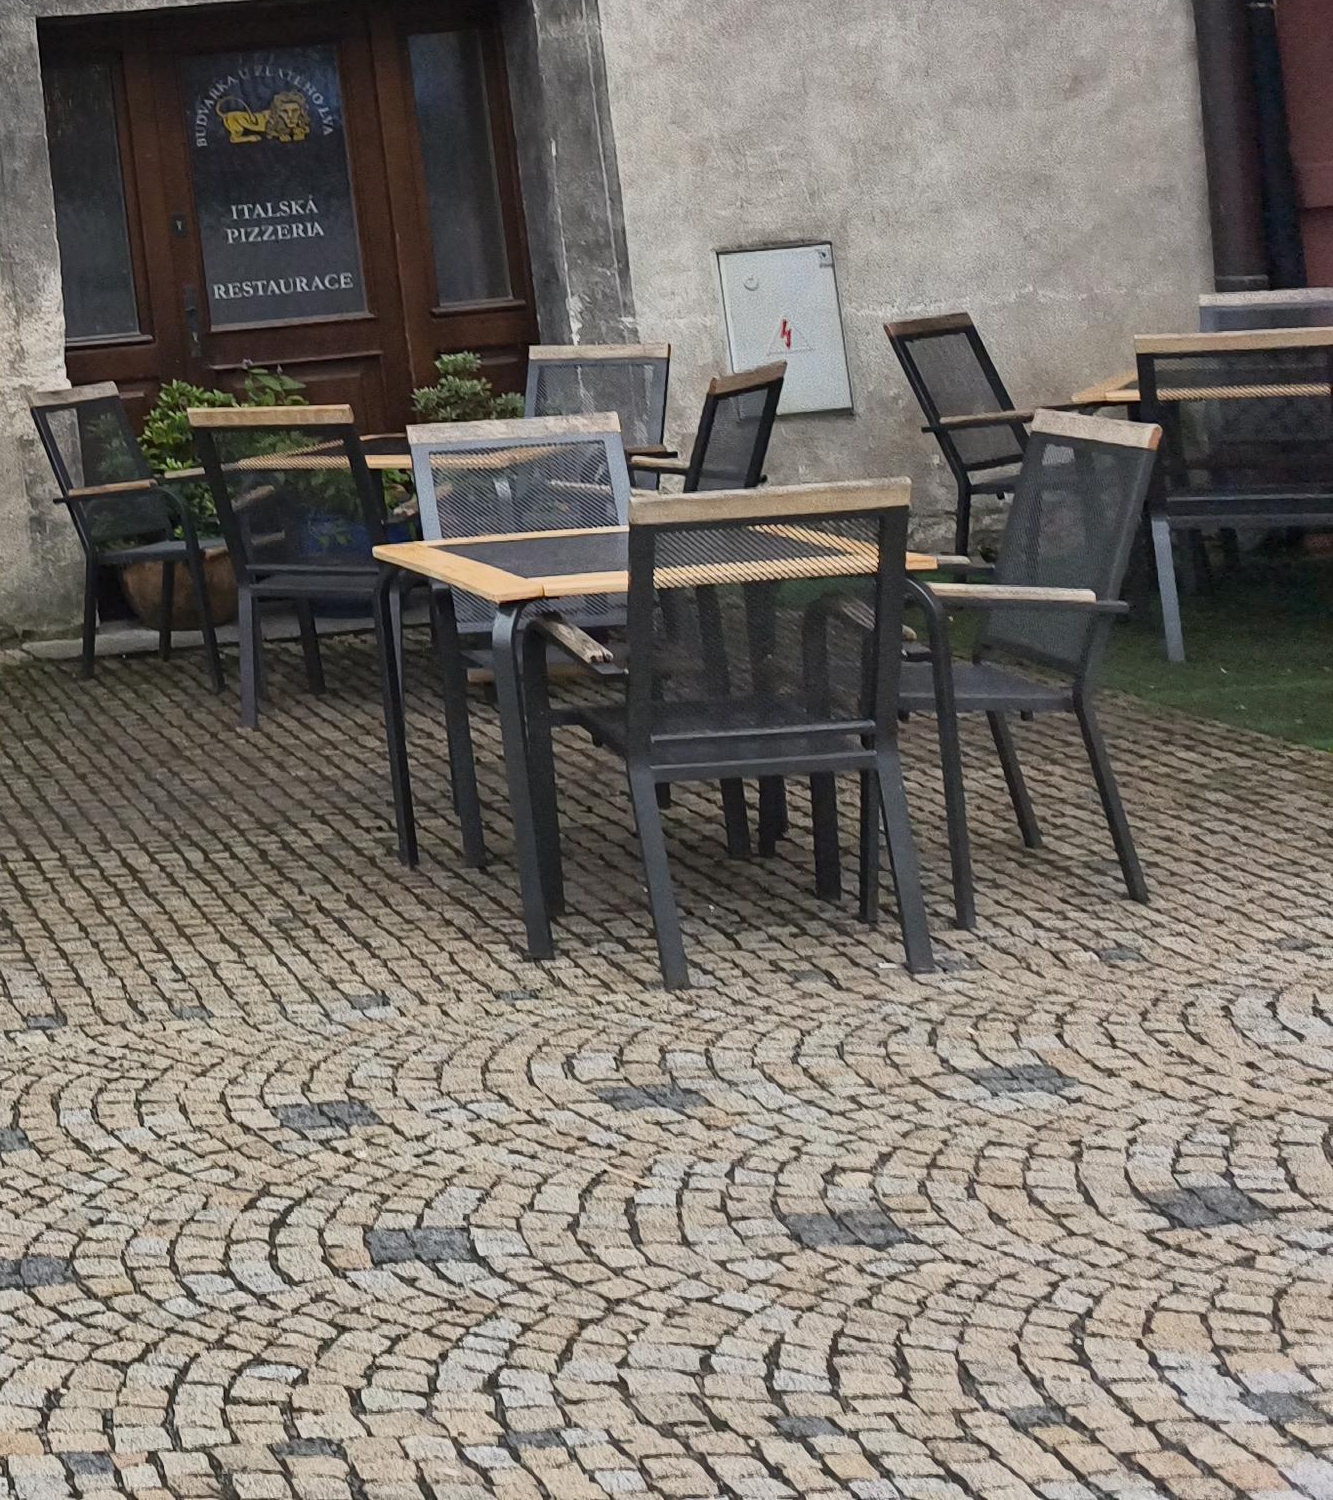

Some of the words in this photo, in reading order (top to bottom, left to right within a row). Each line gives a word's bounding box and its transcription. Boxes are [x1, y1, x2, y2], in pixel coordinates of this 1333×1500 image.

[231, 195, 318, 220] ITALSKÁ
[225, 221, 325, 245] PIZZERIA
[212, 272, 353, 300] RESTAURACE
